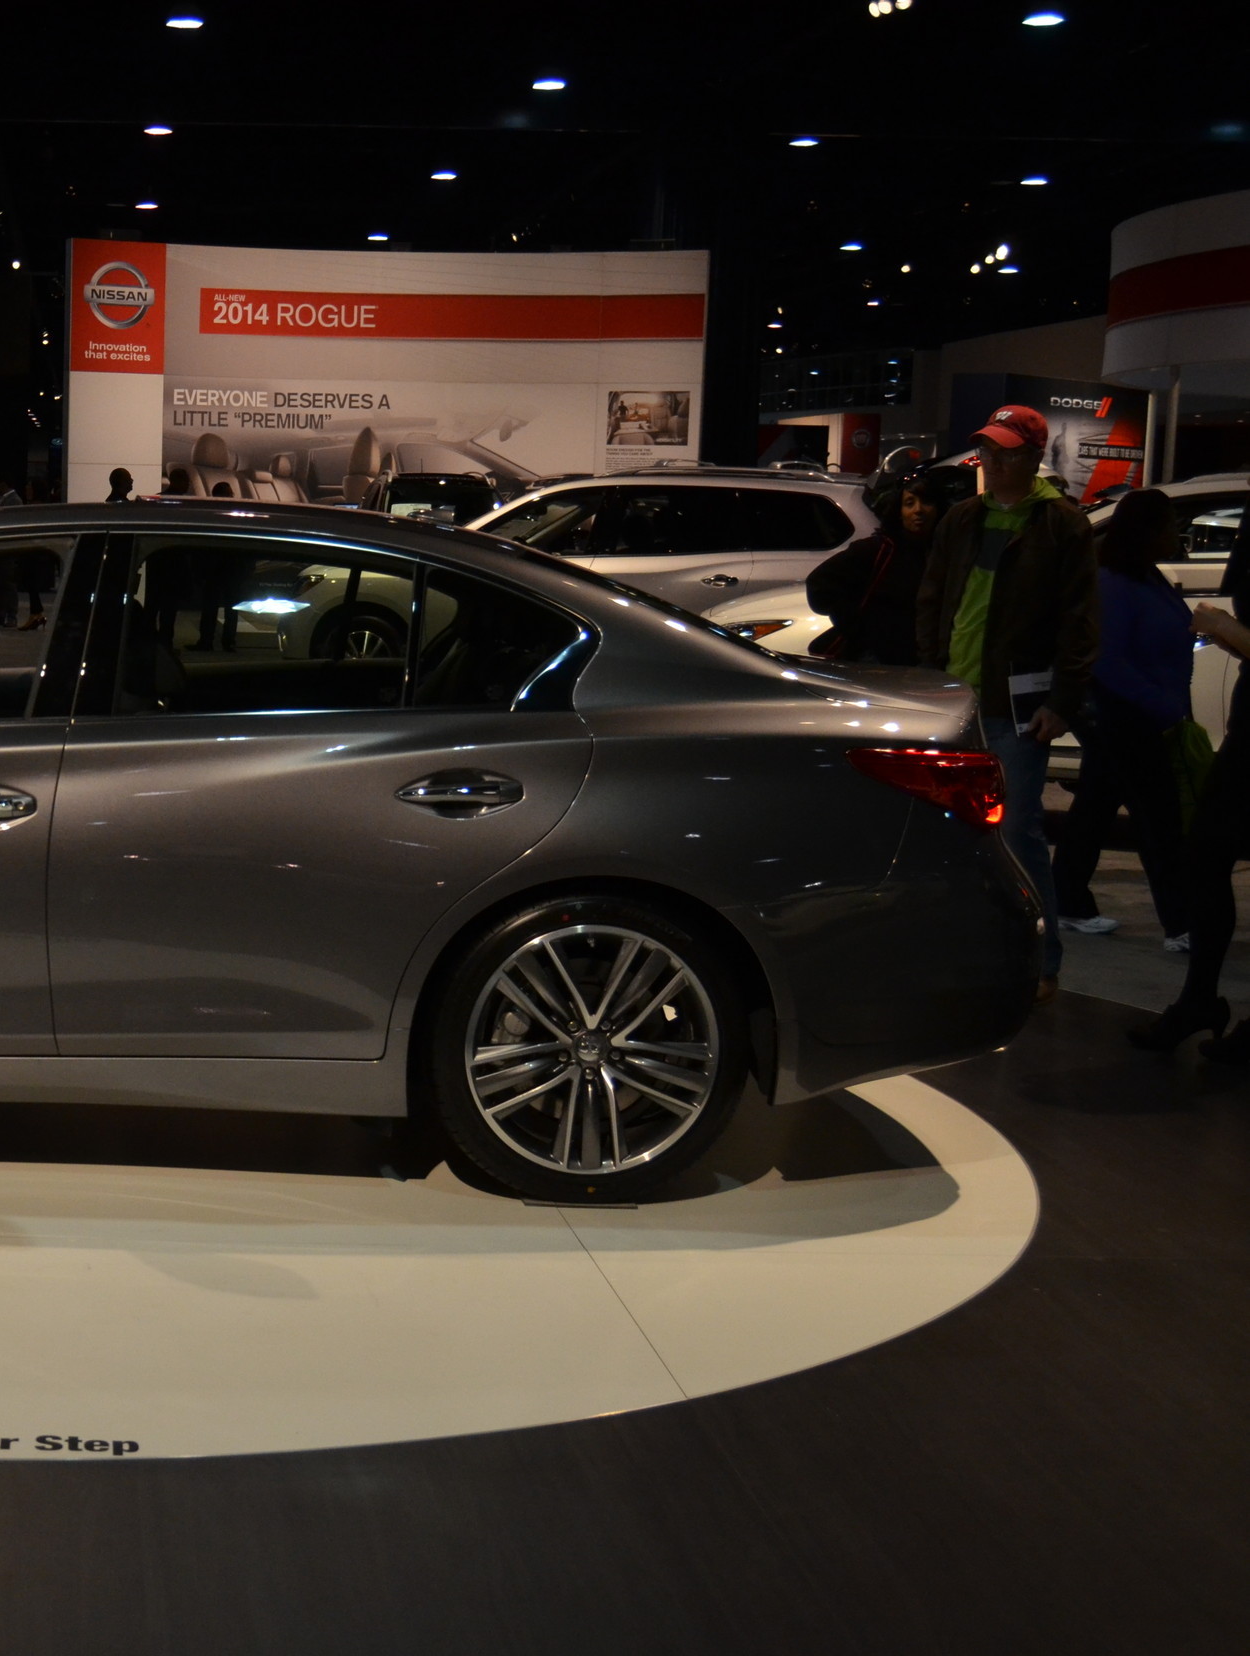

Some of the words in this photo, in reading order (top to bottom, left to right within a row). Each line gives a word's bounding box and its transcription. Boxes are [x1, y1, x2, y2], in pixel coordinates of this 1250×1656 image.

[90, 288, 148, 302] NISSAN
[213, 294, 246, 302] ALL-NEW
[212, 302, 269, 325] 2014
[276, 304, 376, 328] ROGUE
[89, 340, 147, 352] Innovation
[84, 350, 107, 361] that
[109, 351, 151, 362] excites
[173, 388, 268, 408] EVERYONE
[273, 392, 374, 410] DESERVES
[377, 394, 391, 410] A
[1049, 396, 1102, 410] DODGE
[173, 410, 228, 427] LITTLE
[234, 412, 332, 430] “PREMIUM”
[35, 1434, 140, 1456] Step
